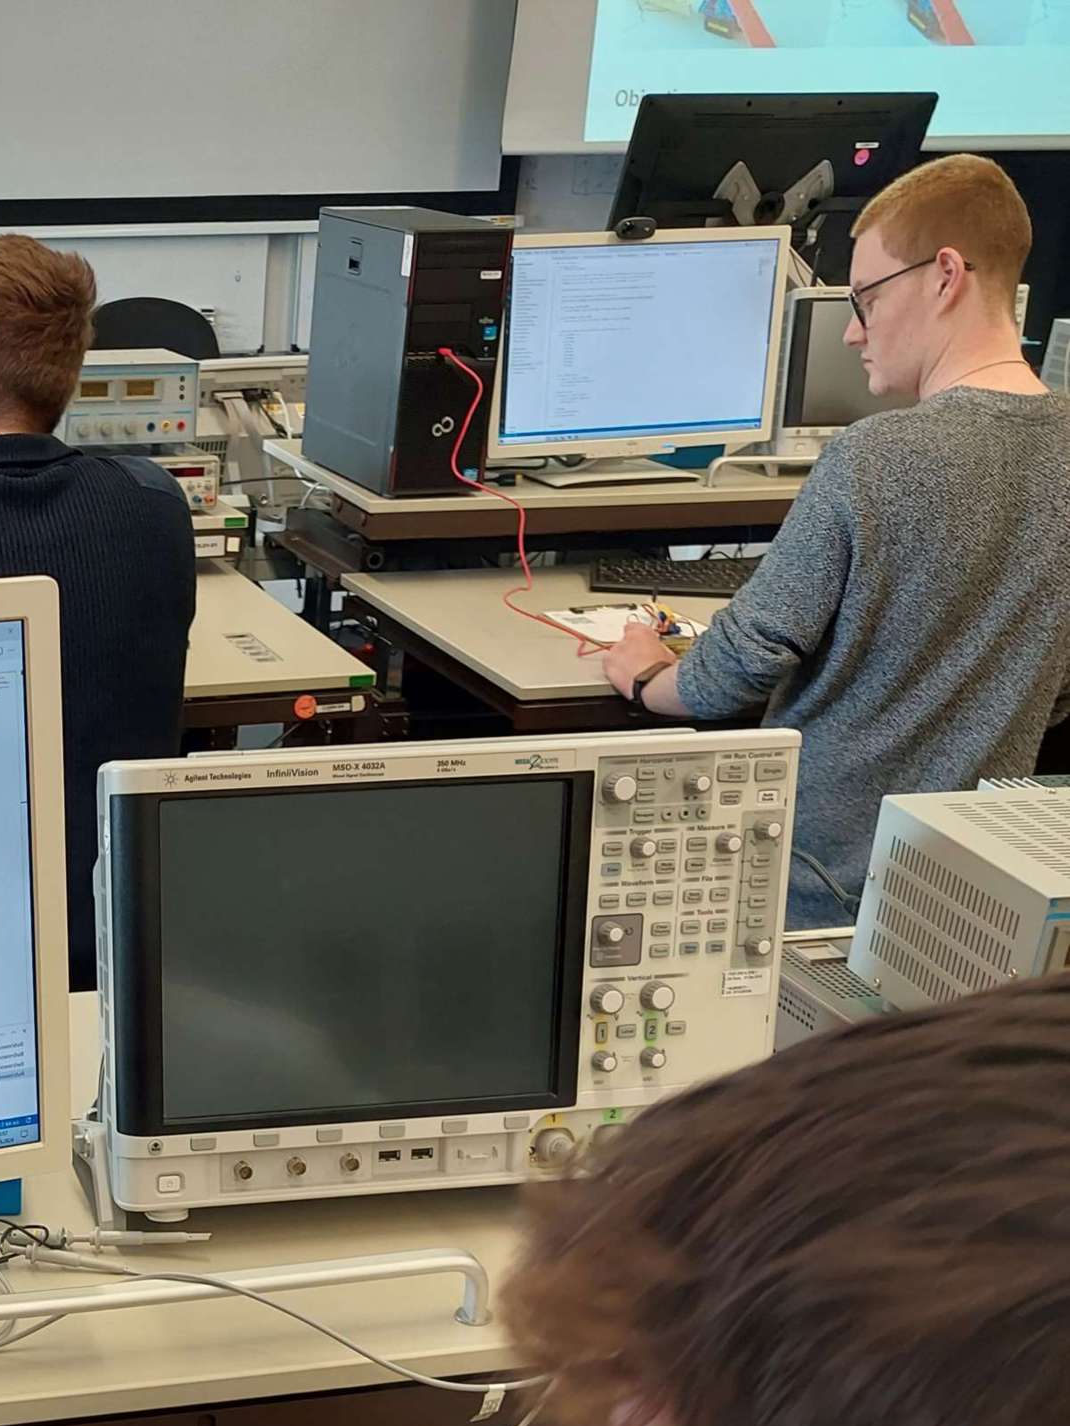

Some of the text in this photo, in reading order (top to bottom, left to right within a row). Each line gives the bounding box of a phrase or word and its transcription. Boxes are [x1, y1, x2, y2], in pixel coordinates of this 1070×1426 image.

[361, 762, 386, 770] 4032A
[184, 772, 252, 782] Agilent Technologies
[649, 1026, 656, 1034] 2
[610, 1109, 616, 1118] 2
